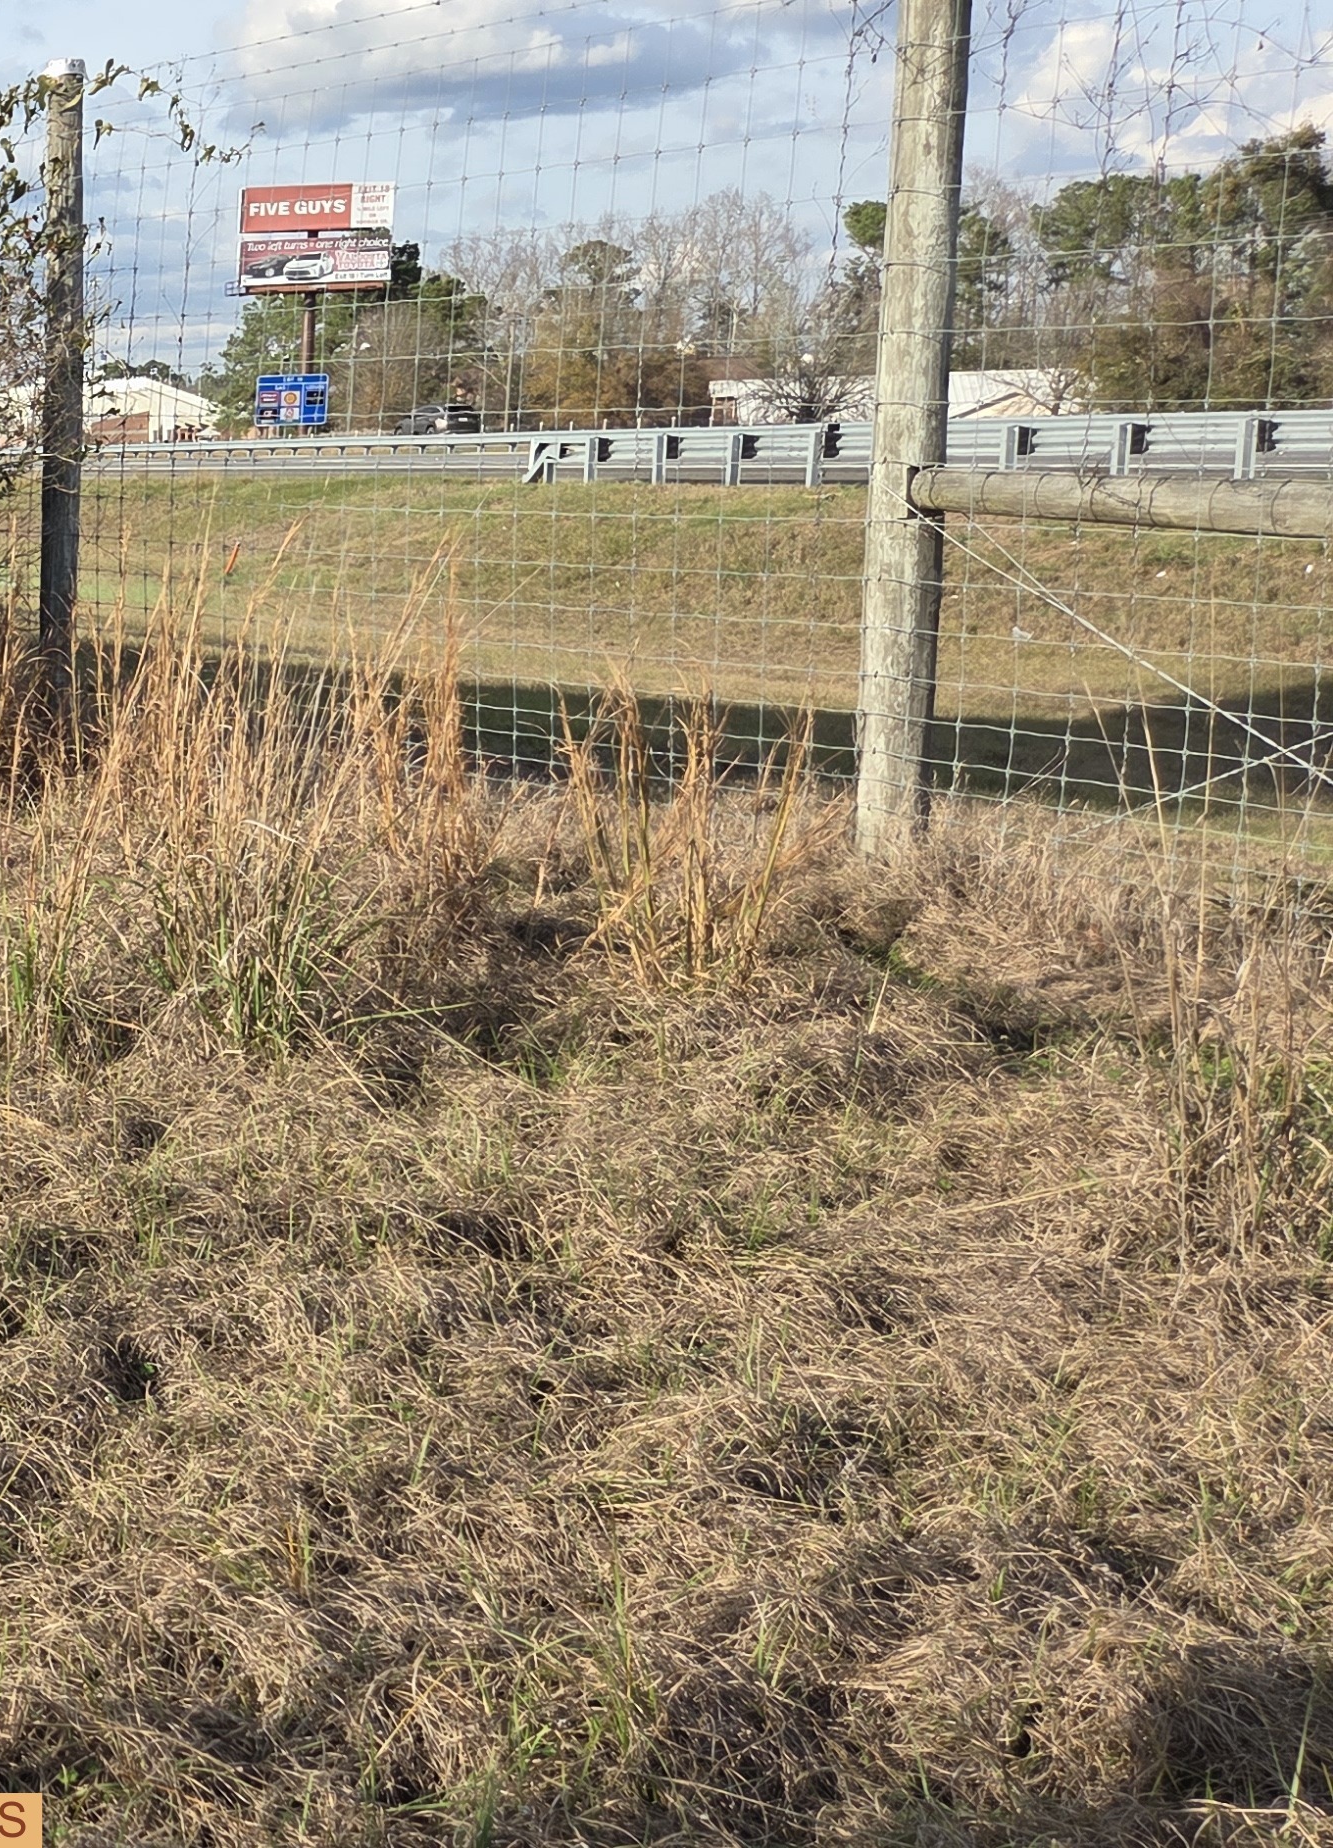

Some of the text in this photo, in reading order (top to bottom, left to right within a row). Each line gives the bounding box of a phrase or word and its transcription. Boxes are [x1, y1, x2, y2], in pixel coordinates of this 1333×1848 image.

[249, 199, 346, 217] FIVE GUYS
[247, 243, 266, 252] Two
[283, 241, 309, 250] turns
[315, 240, 334, 249] one
[334, 238, 358, 251] right
